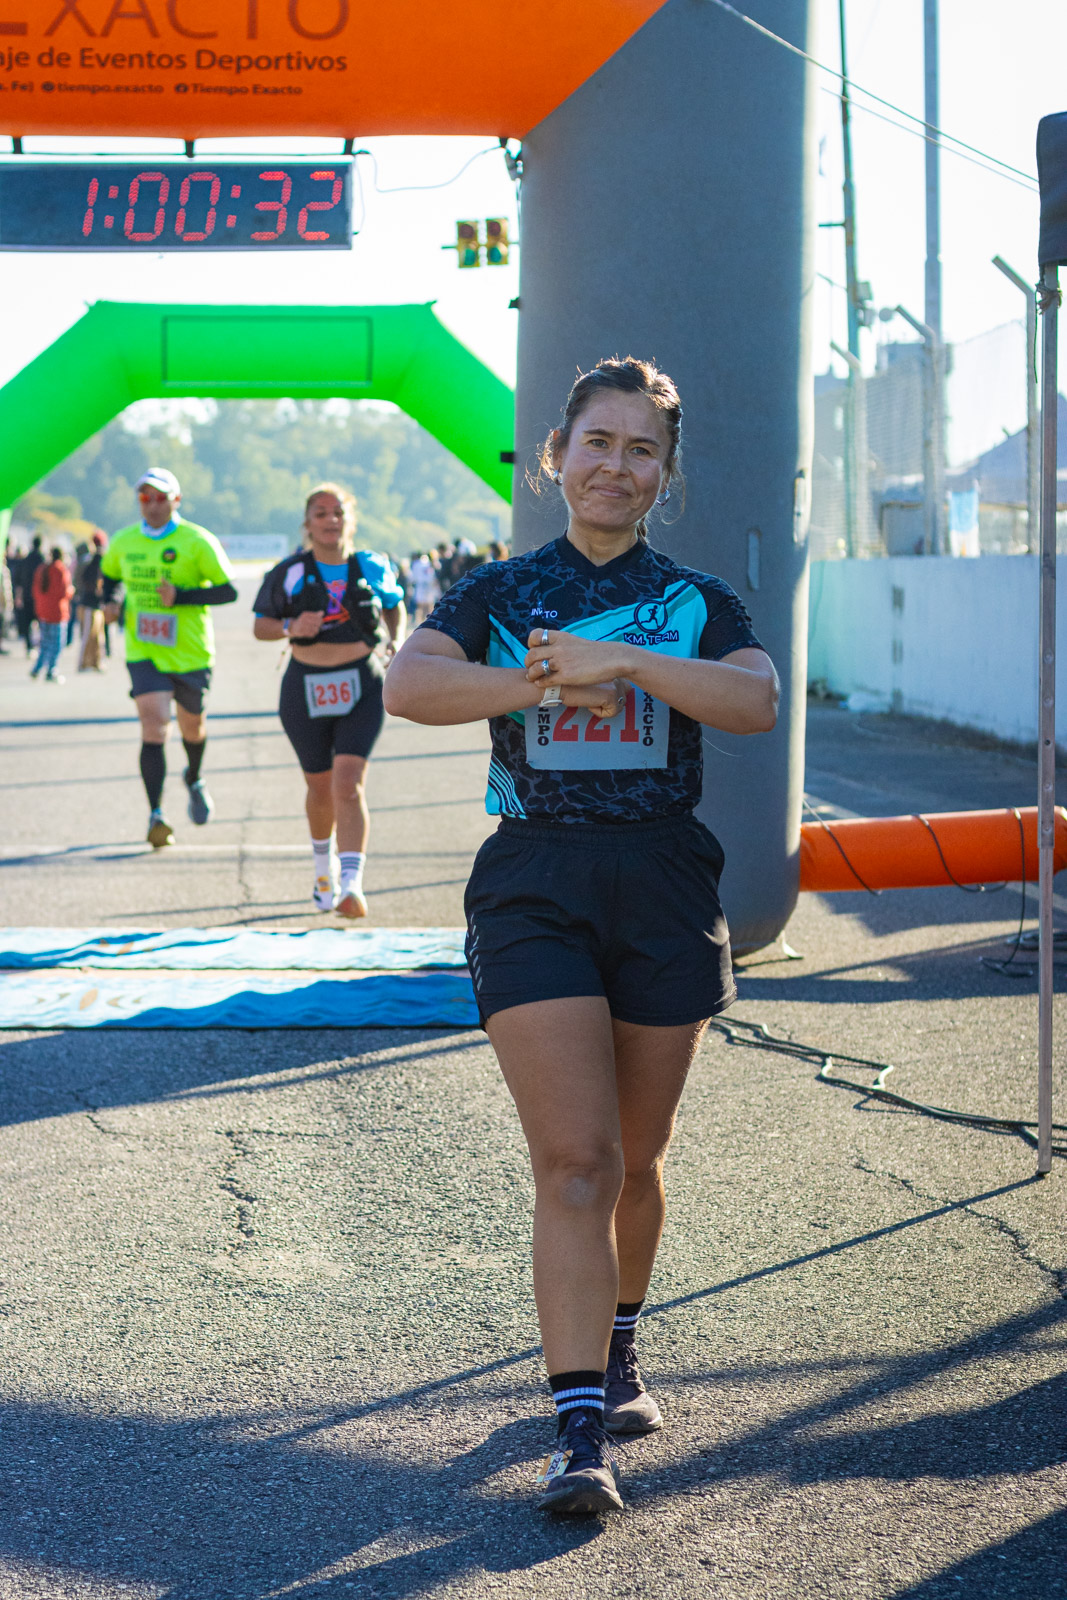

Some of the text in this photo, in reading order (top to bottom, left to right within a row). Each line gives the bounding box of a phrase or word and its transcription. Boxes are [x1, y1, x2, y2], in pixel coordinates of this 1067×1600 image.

[0, 0, 349, 40] XACTO
[37, 46, 71, 68] de
[79, 48, 187, 69] Eventos
[196, 49, 348, 74] Deportivos
[57, 82, 164, 95] tiempo.exacto
[192, 83, 249, 96] Tiempo
[252, 84, 303, 96] Exacto
[82, 171, 344, 241] 1:00:32
[647, 630, 679, 645] TEAM
[315, 681, 351, 706] 236
[642, 691, 655, 747] XACTO
